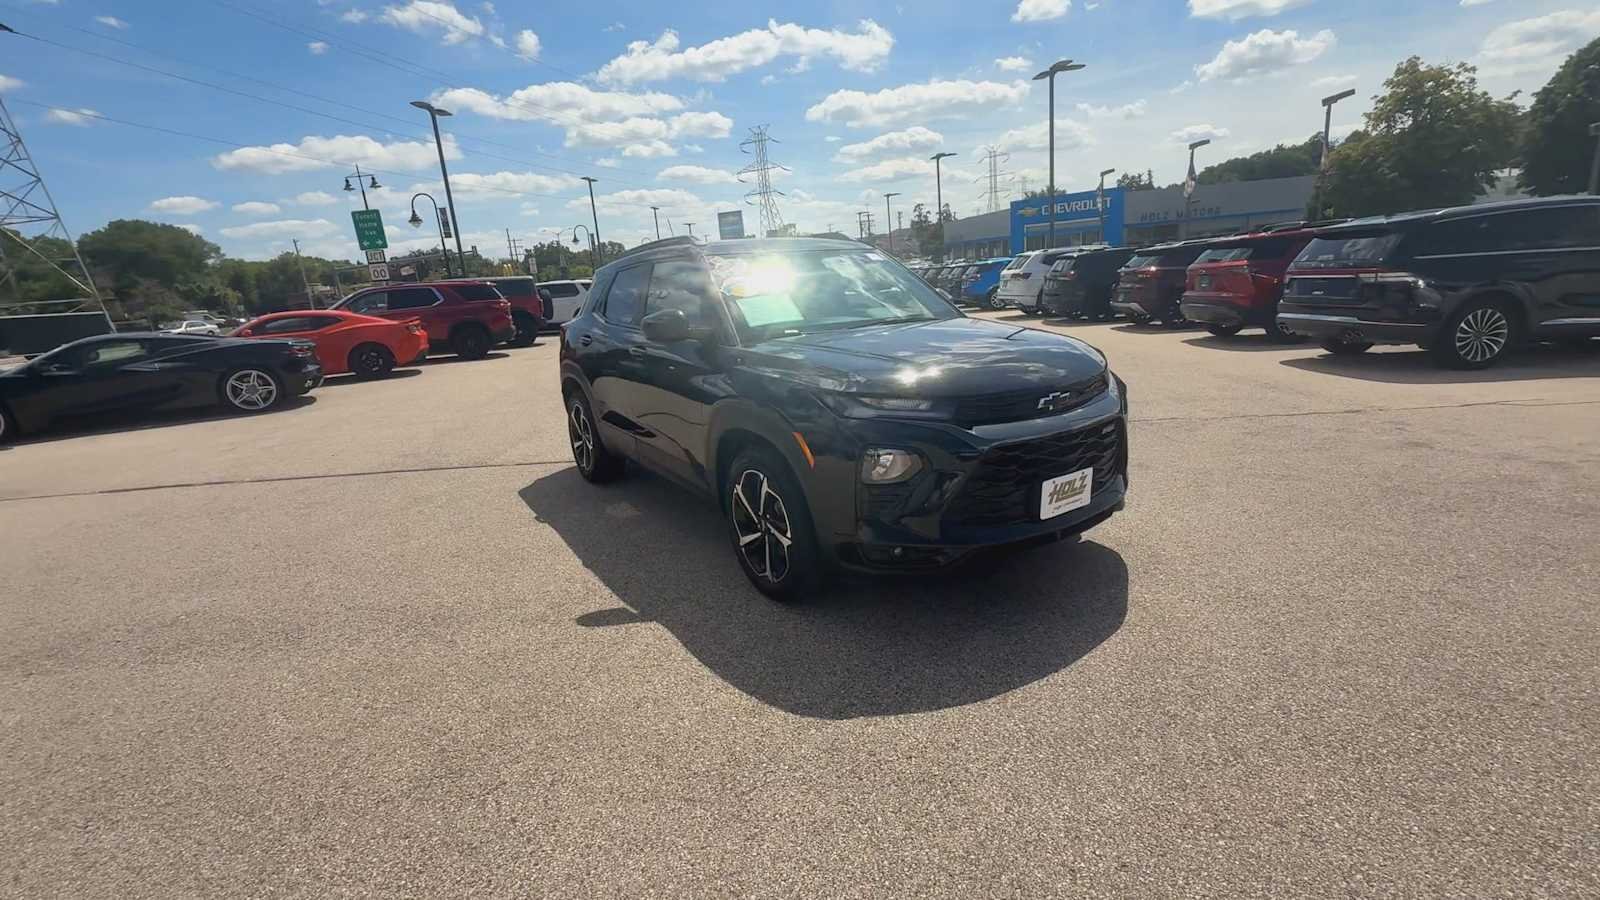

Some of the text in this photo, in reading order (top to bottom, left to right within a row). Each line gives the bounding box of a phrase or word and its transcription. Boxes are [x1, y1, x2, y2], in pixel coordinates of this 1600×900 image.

[1041, 197, 1112, 216] CEVROLT
[1176, 206, 1221, 217] MTORS
[1048, 474, 1088, 505] HOLZ
